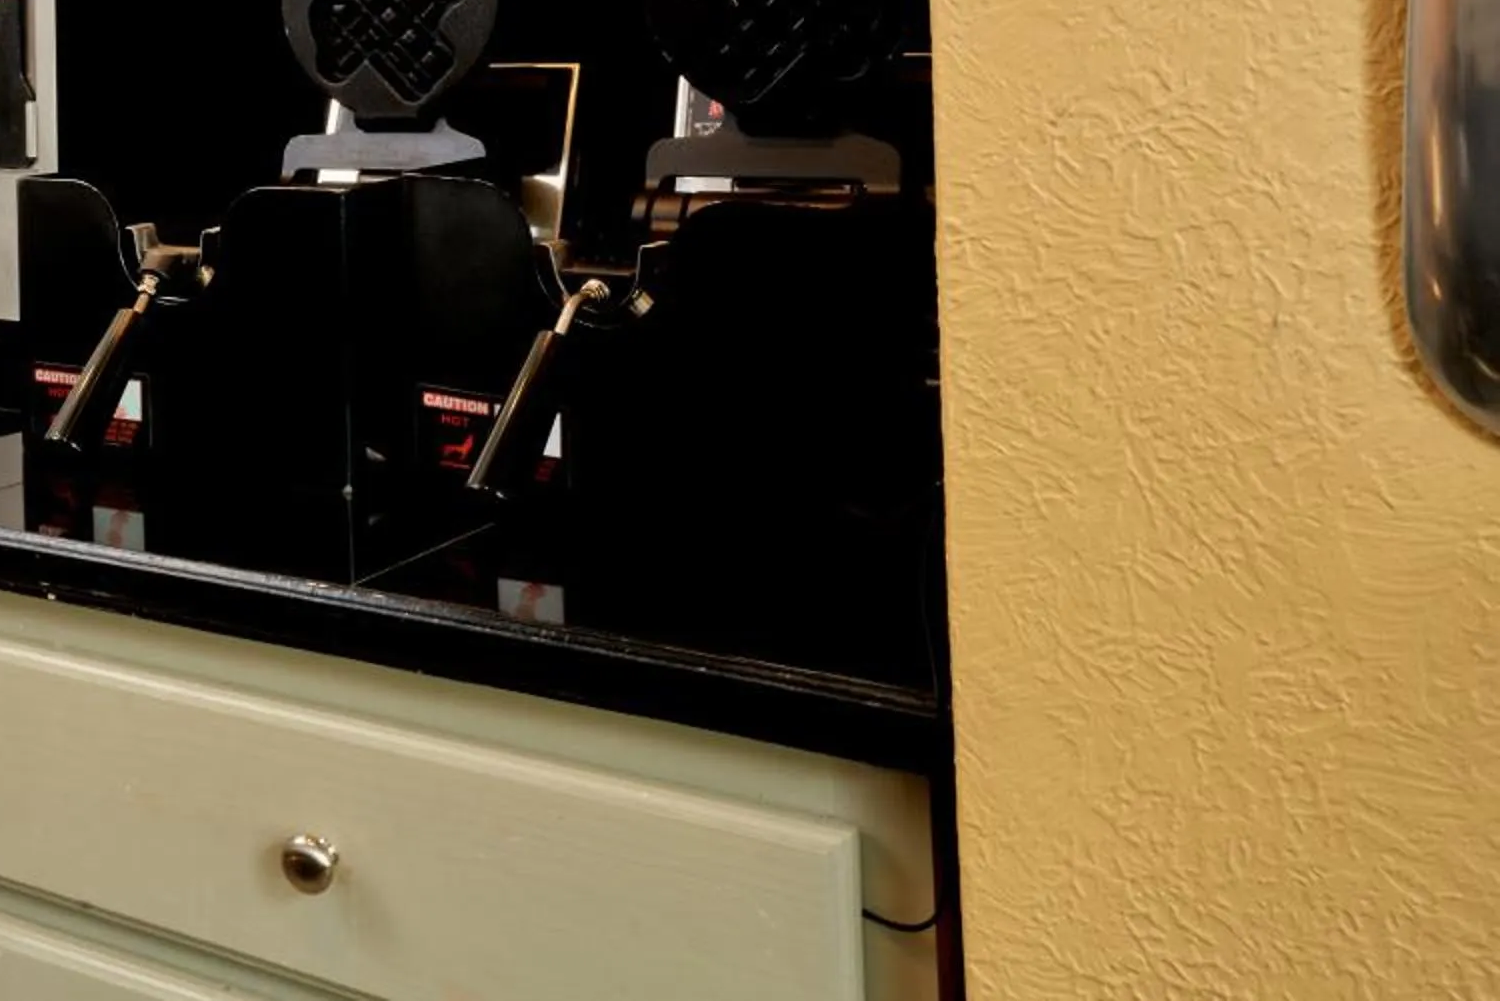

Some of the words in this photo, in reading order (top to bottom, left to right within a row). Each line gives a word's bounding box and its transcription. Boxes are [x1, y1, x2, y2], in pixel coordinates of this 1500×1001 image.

[35, 368, 80, 385] CAUTIO
[423, 391, 489, 415] CAUTION
[441, 414, 470, 428] HOT
